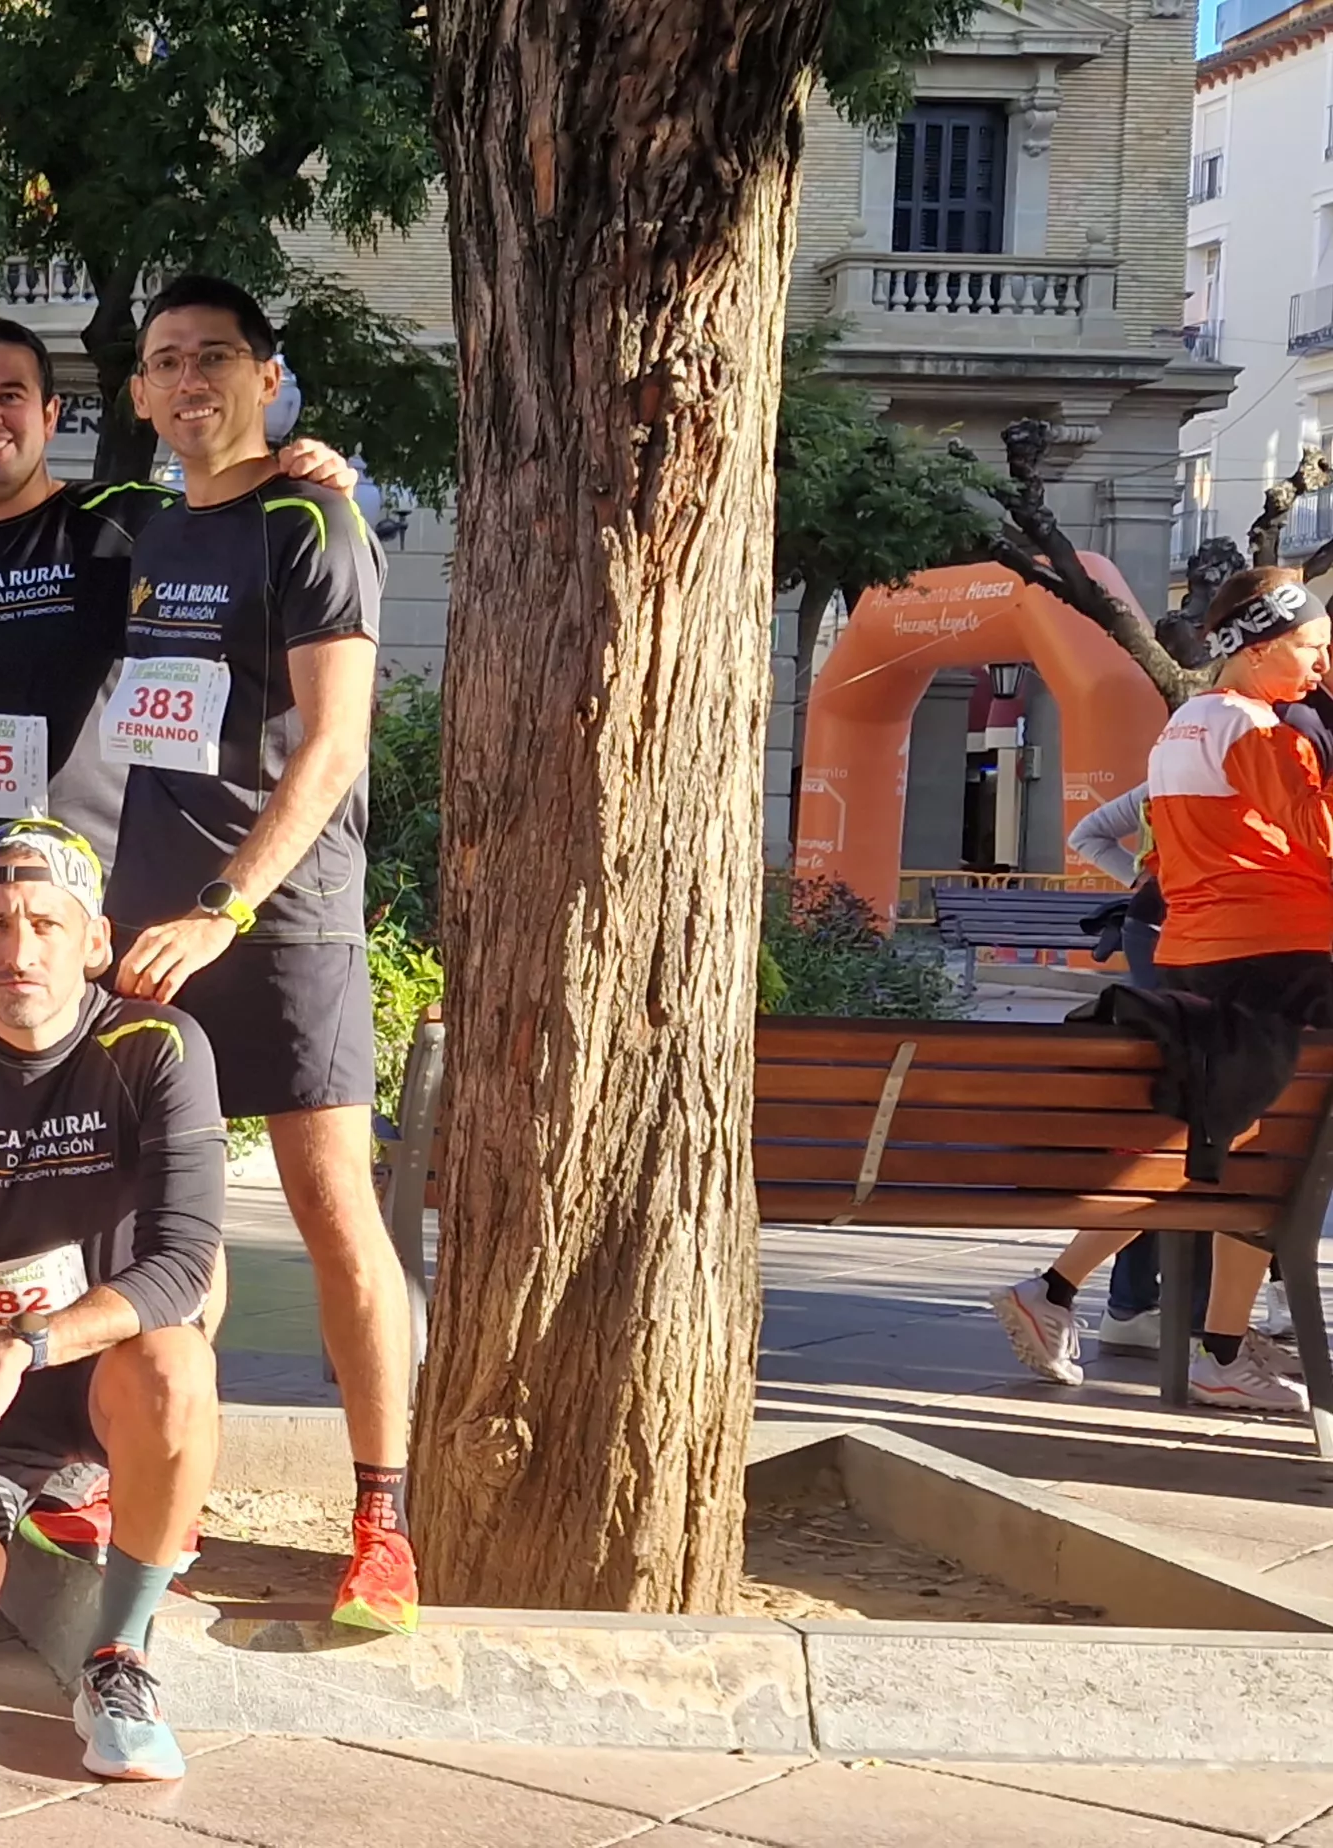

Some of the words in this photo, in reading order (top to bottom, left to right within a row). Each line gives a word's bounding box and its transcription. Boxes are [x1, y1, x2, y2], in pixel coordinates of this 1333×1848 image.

[10, 563, 76, 587] RURAL
[155, 582, 186, 600] CAJA
[188, 584, 230, 603] RURAL
[966, 581, 1014, 600] Huesca
[158, 605, 174, 618] DE
[175, 606, 216, 620] ARAGÓN
[129, 686, 194, 722] 383
[117, 721, 199, 742] FERNANDO
[133, 739, 153, 754] 8K
[39, 1111, 107, 1139] RURAL
[28, 1137, 94, 1160] ARAGÓN
